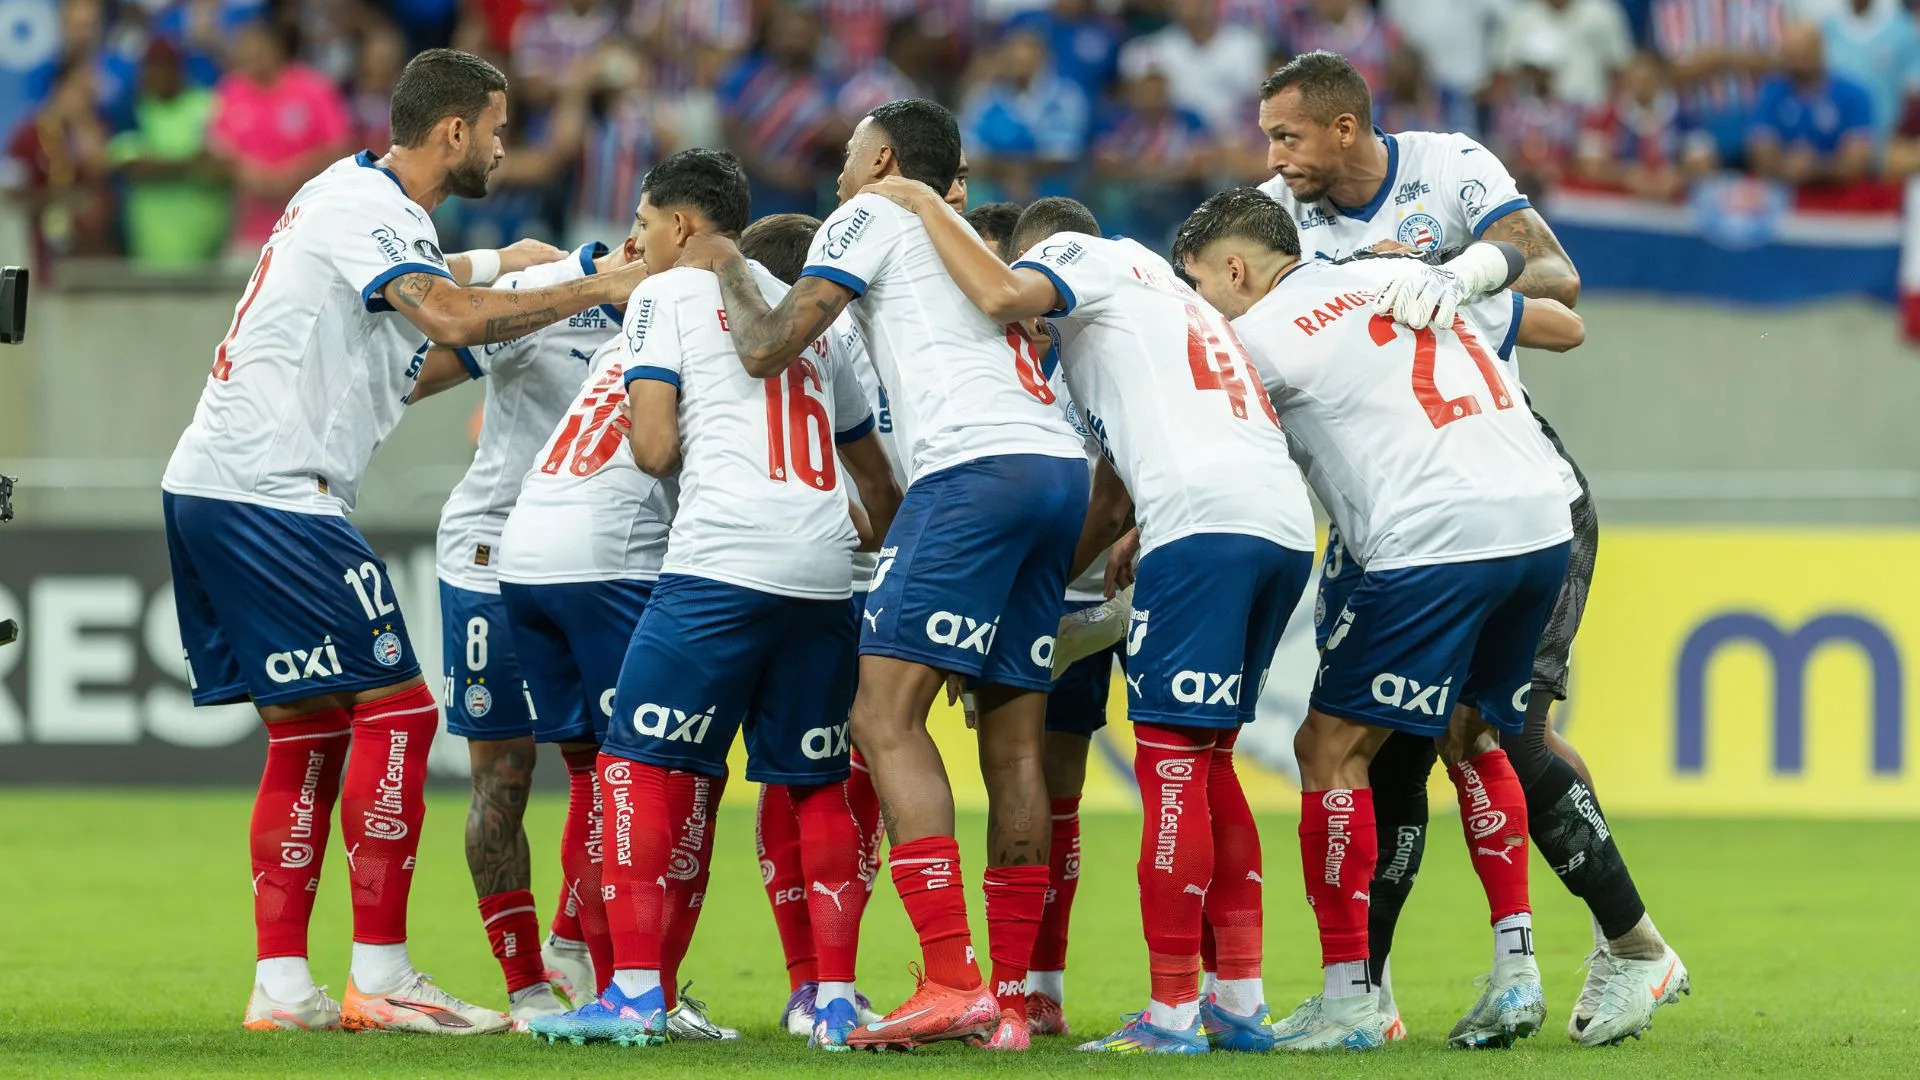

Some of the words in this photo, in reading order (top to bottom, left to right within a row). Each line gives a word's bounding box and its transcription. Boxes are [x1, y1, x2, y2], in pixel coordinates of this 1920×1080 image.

[1054, 241, 1083, 268] anaã
[569, 317, 607, 328] SORTE
[1368, 308, 1514, 429] 21
[764, 357, 836, 492] 16
[344, 561, 395, 621] 12
[466, 616, 488, 672] 8
[926, 610, 1000, 656] axi
[0, 576, 258, 746] ES
[265, 634, 343, 684] axi
[1371, 672, 1453, 716] axi
[633, 701, 717, 745] axi
[997, 980, 1027, 998] PRO
